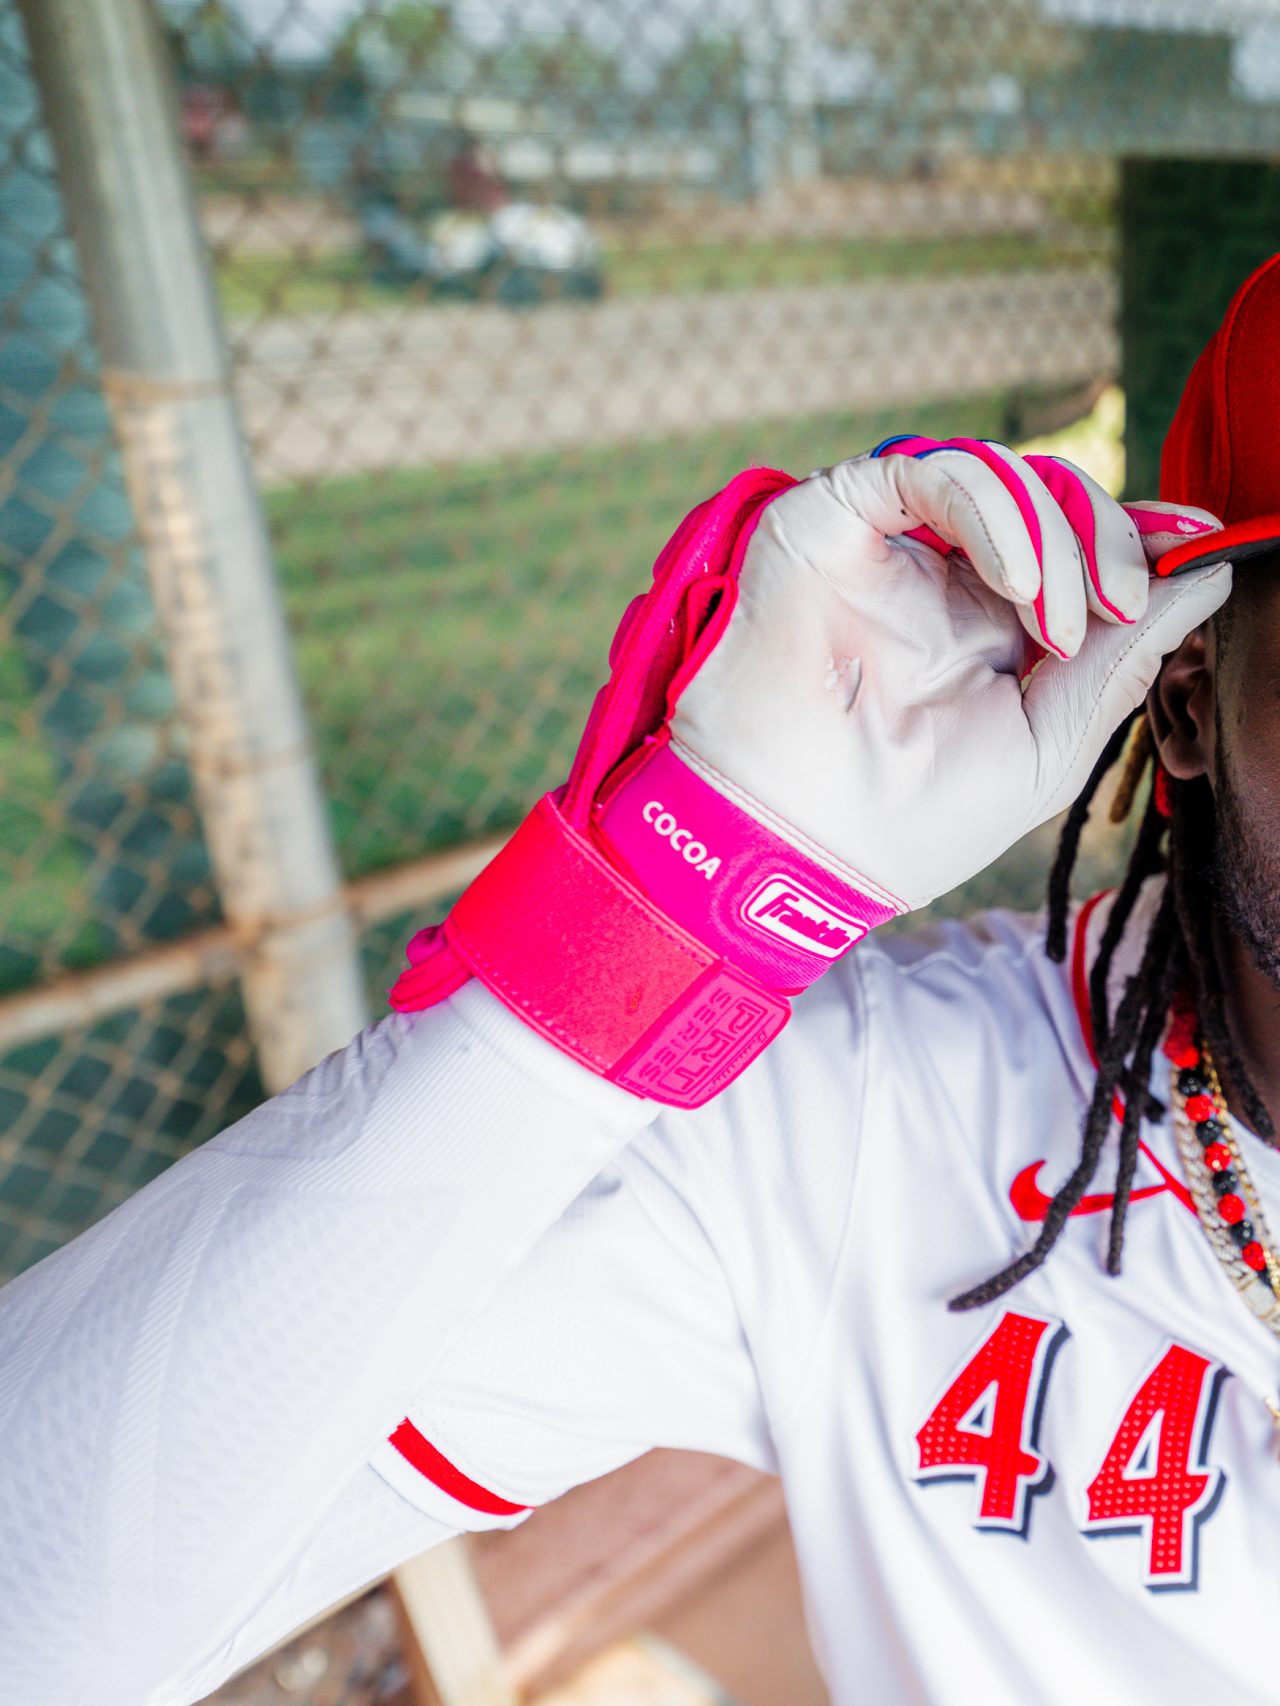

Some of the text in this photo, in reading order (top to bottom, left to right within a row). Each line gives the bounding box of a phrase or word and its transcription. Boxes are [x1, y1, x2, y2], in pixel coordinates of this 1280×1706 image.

[642, 800, 722, 881] COCOA
[639, 987, 732, 1083] SERIES
[911, 1311, 1235, 1593] 44
